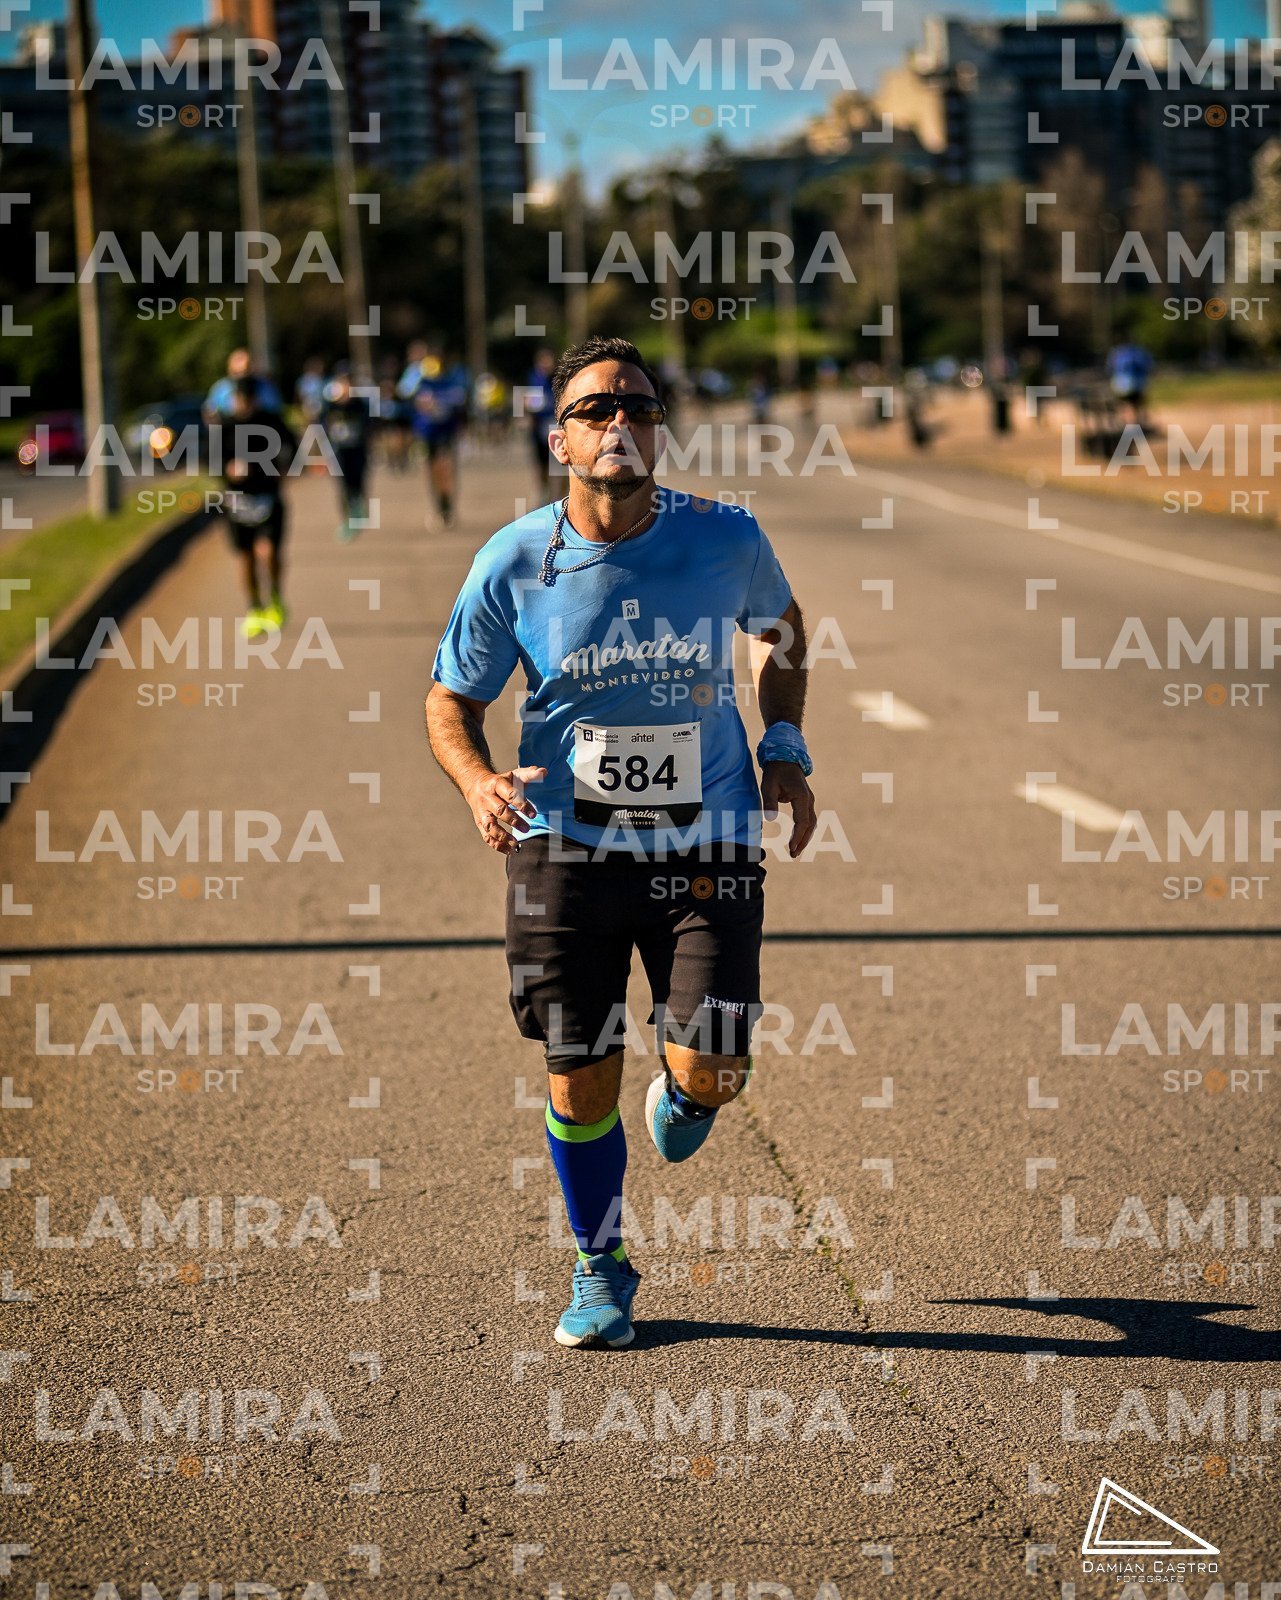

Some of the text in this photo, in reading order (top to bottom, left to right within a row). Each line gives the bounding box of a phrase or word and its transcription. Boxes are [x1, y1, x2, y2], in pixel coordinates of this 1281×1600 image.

[560, 633, 710, 680] Maratón
[581, 668, 695, 693] MONTEVIDEO
[598, 754, 678, 793] 584
[614, 808, 661, 820] Maratón
[702, 994, 746, 1016] EXPERT
